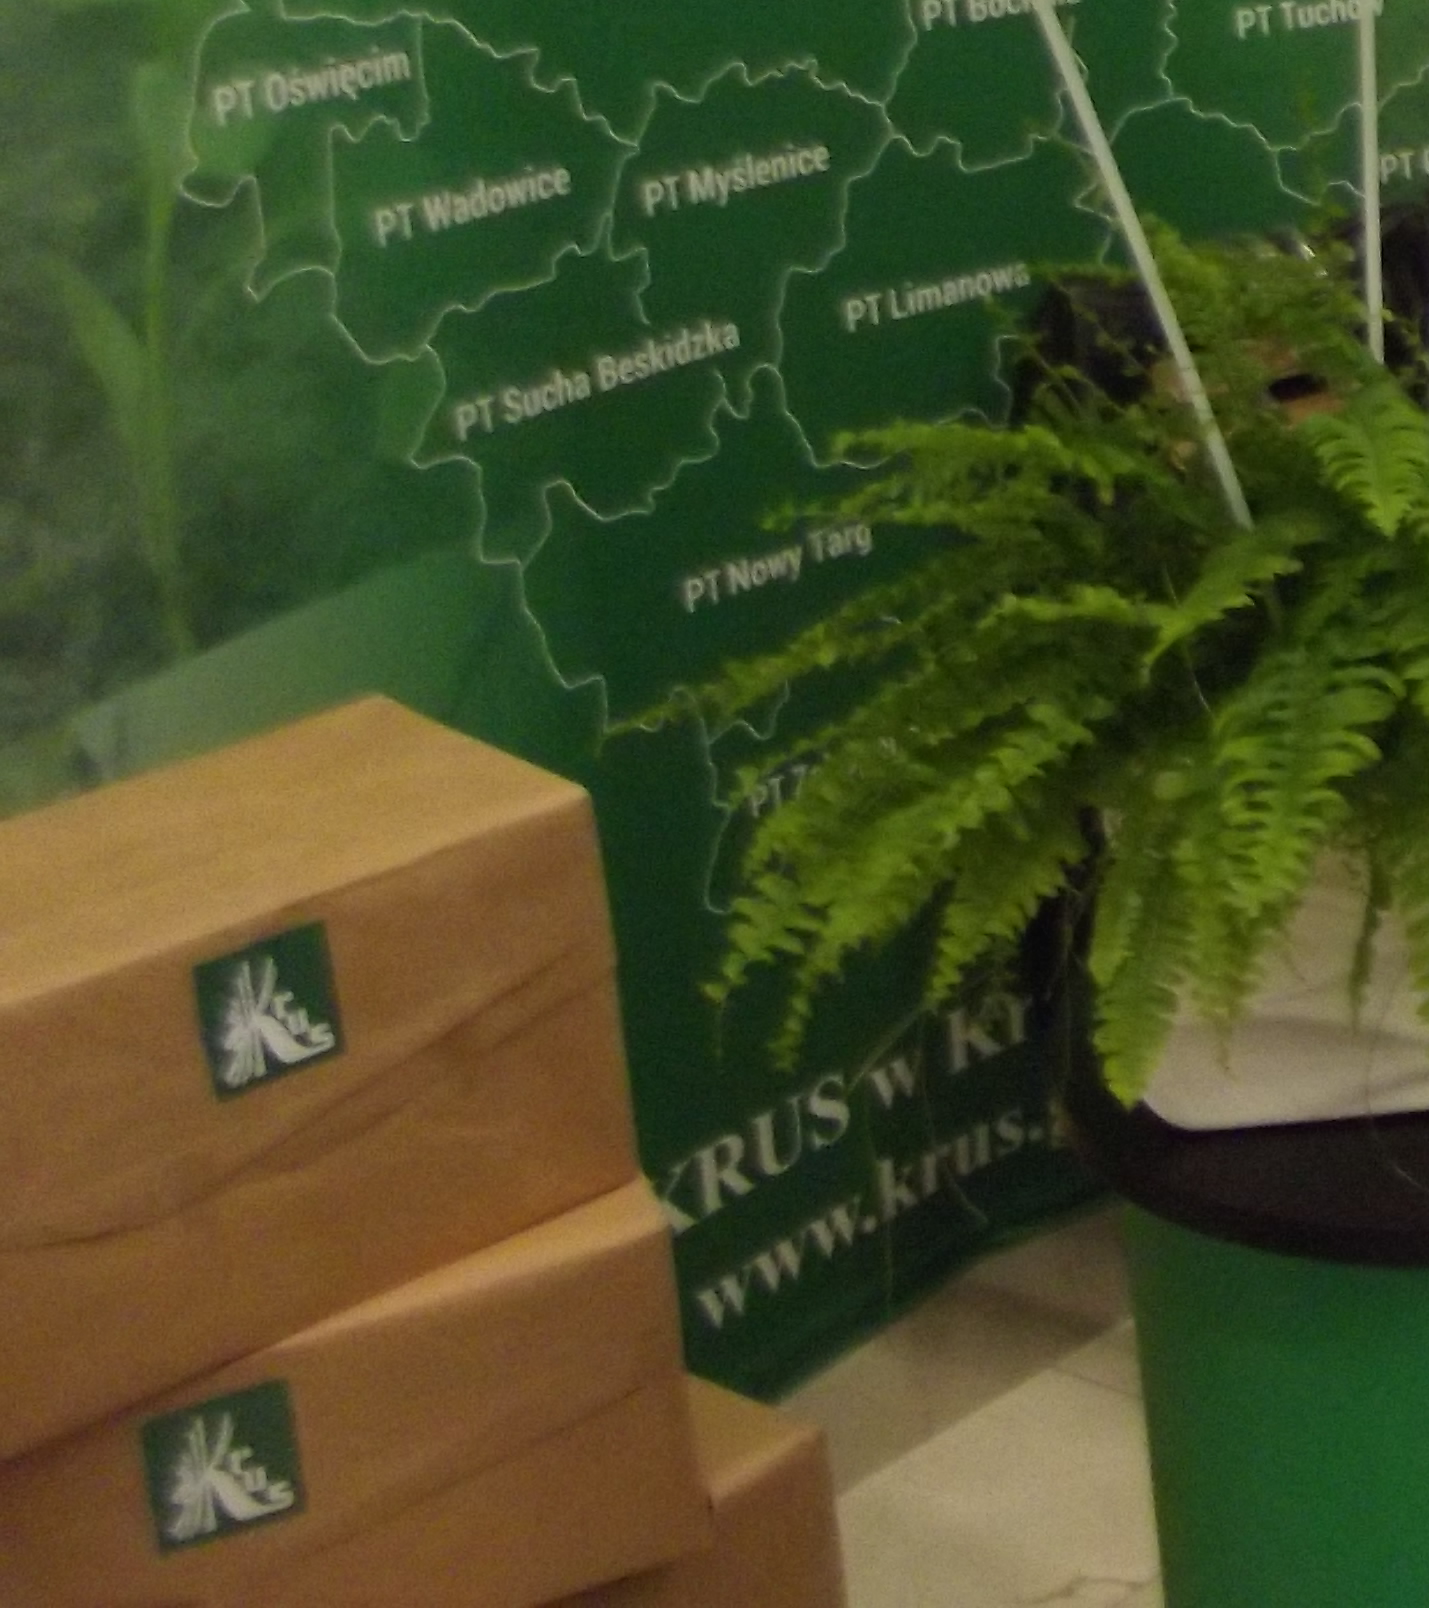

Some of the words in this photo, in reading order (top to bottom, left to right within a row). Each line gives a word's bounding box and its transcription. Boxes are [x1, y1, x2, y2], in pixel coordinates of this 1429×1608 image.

[1234, 5, 1272, 41] PT
[213, 79, 254, 128] PT
[1379, 150, 1414, 185] PT
[374, 202, 413, 247] PT
[422, 165, 572, 232] Wadowice
[643, 175, 680, 218] PT
[845, 293, 881, 334] PT
[453, 396, 495, 442] PT
[501, 369, 591, 424] Sucha
[683, 569, 721, 613] PT
